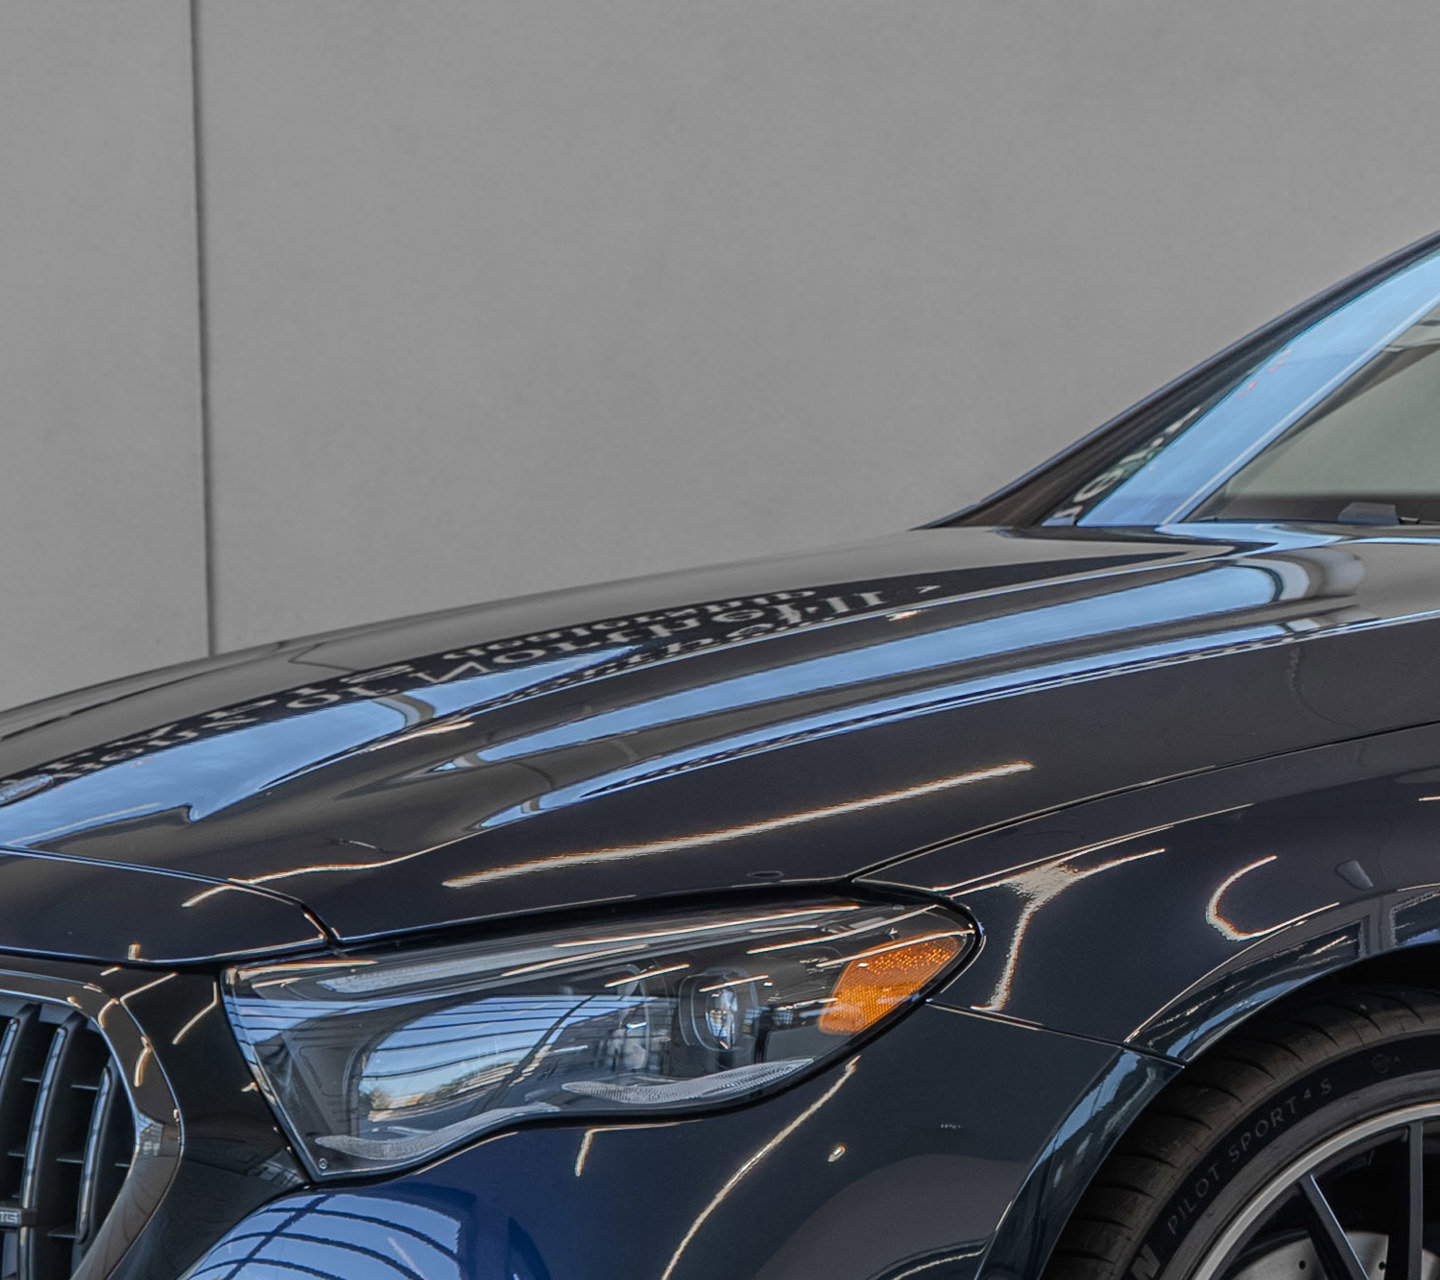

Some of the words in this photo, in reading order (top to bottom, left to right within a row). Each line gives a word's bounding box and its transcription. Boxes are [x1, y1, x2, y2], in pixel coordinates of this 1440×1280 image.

[1166, 1165, 1221, 1237] PILOT
[1228, 1096, 1297, 1165] SPORT
[1318, 1079, 1335, 1098] S
